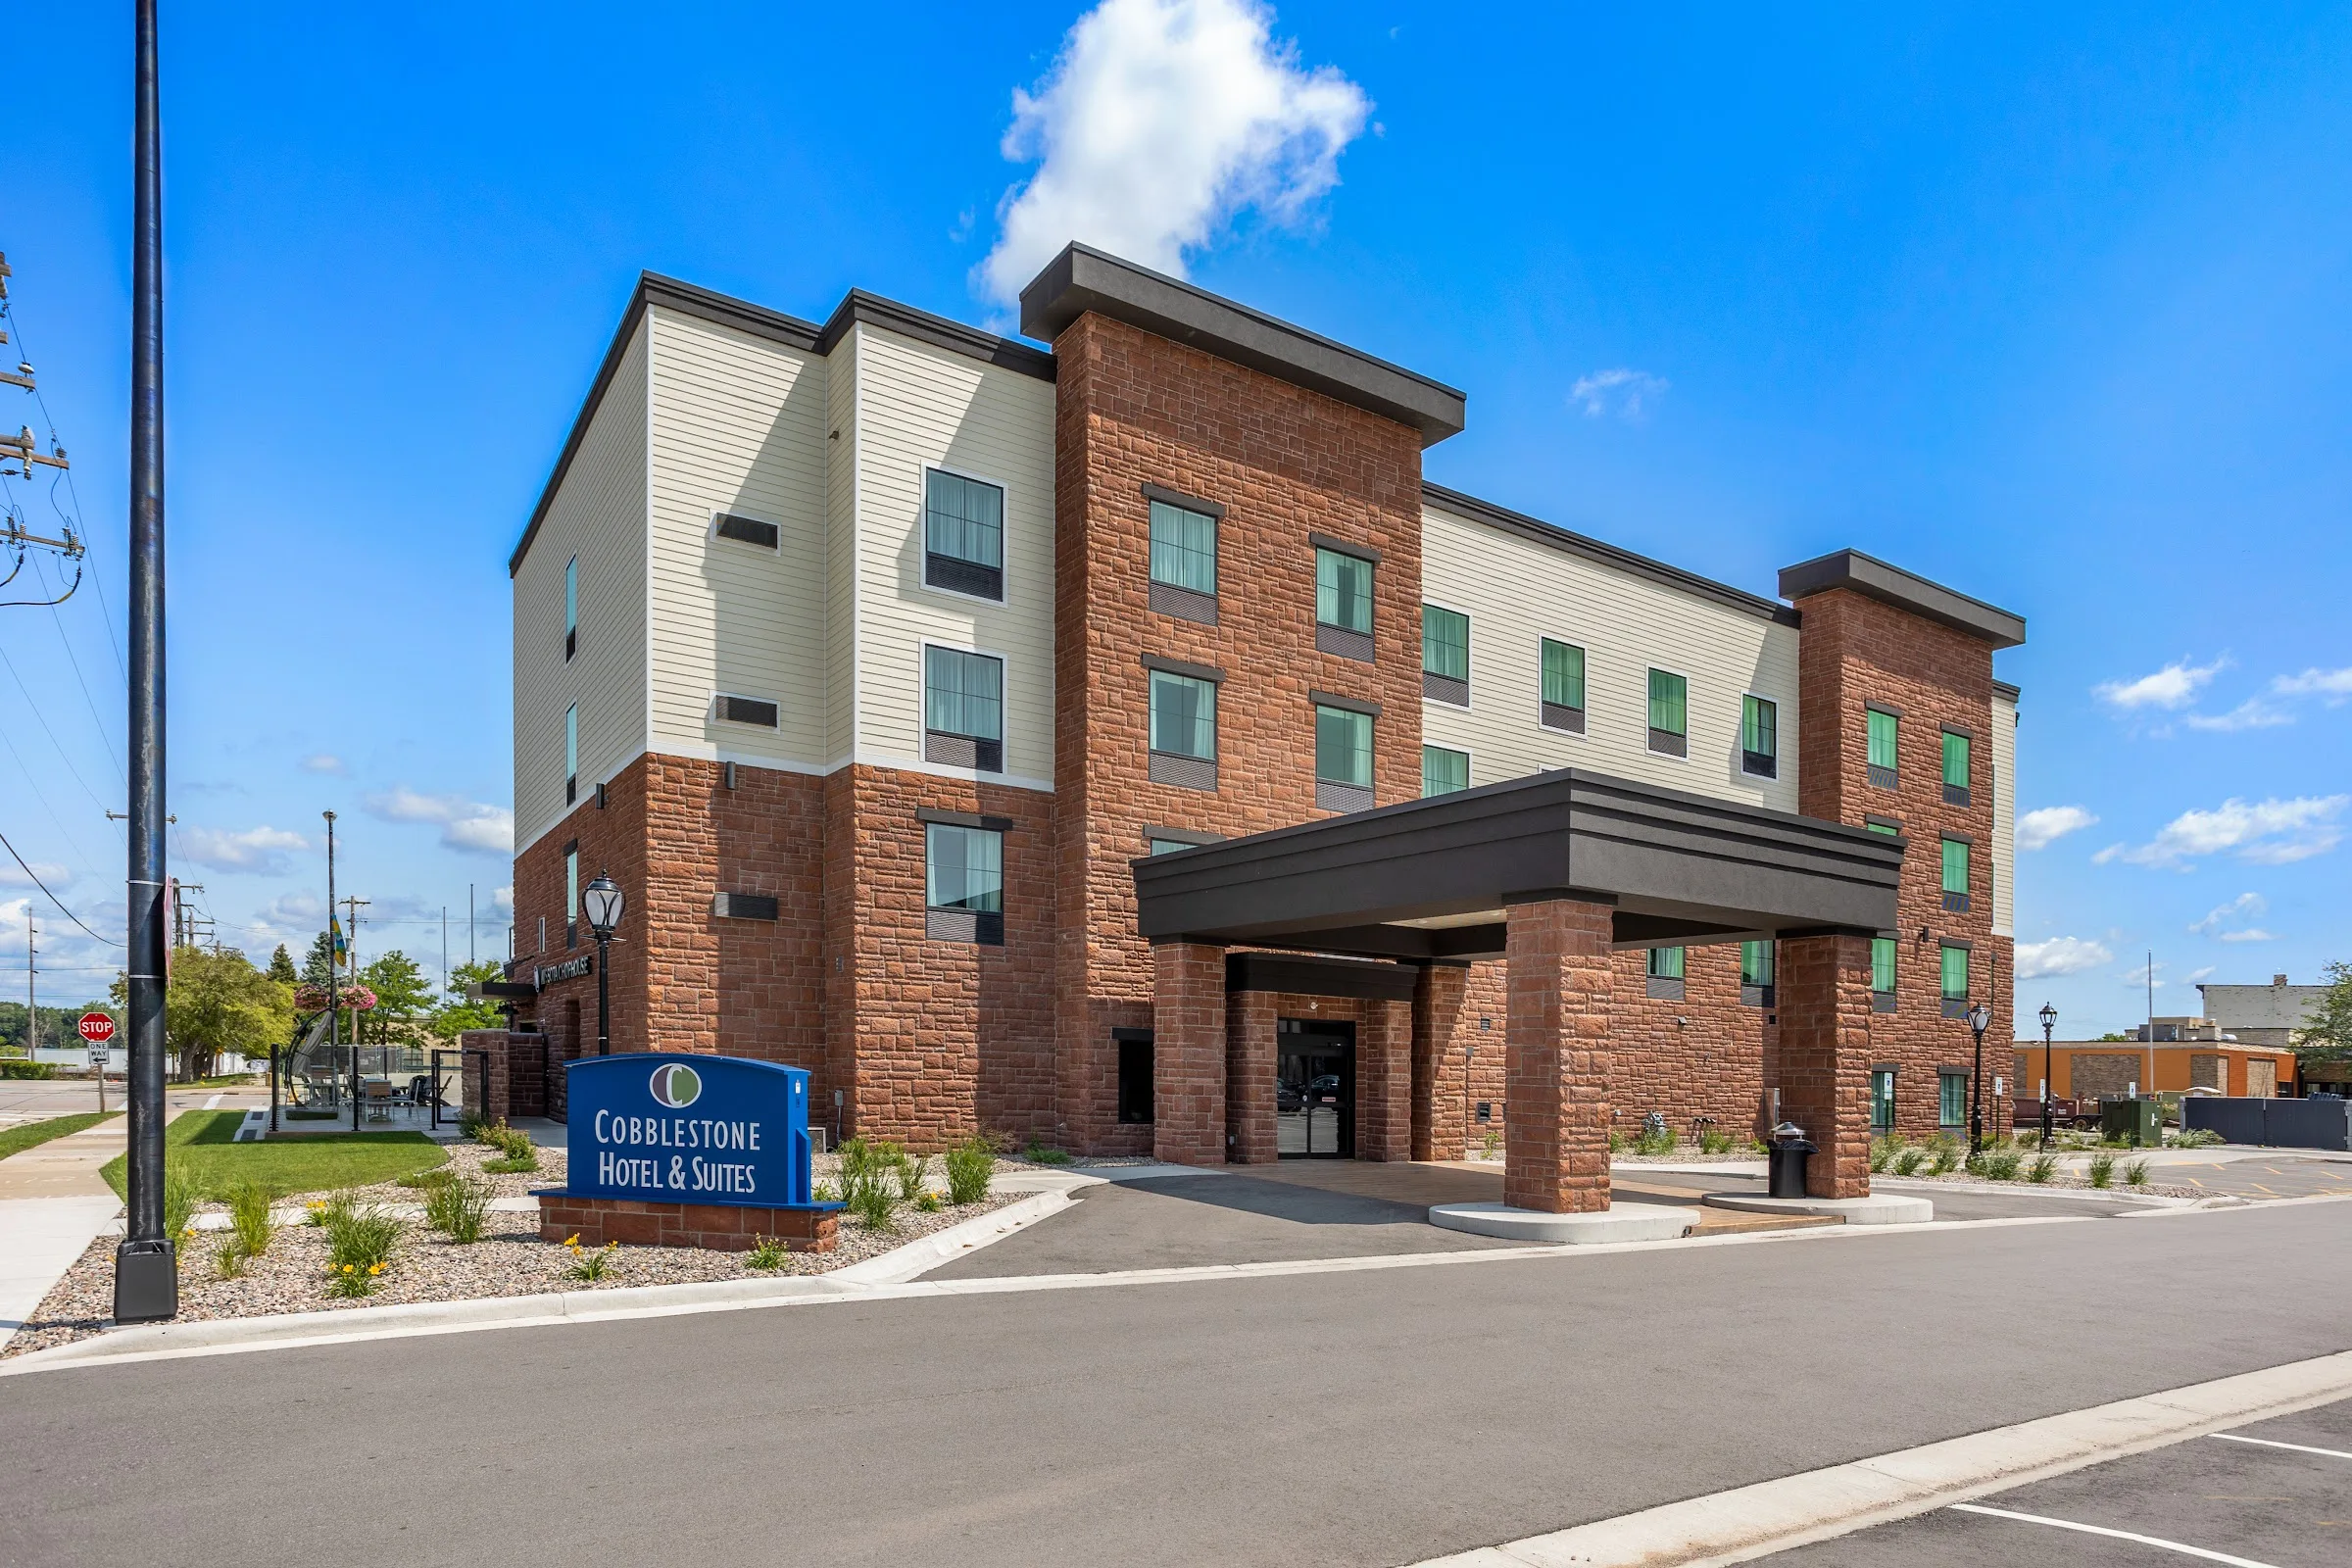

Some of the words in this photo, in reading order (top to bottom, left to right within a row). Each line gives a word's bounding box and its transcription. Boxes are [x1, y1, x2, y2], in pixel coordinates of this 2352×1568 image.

[81, 1021, 113, 1033] STOP
[595, 1109, 760, 1152] COBBLESTONE
[599, 1152, 663, 1189] HOTEL
[668, 1155, 686, 1191] &
[692, 1155, 756, 1194] SUITES
